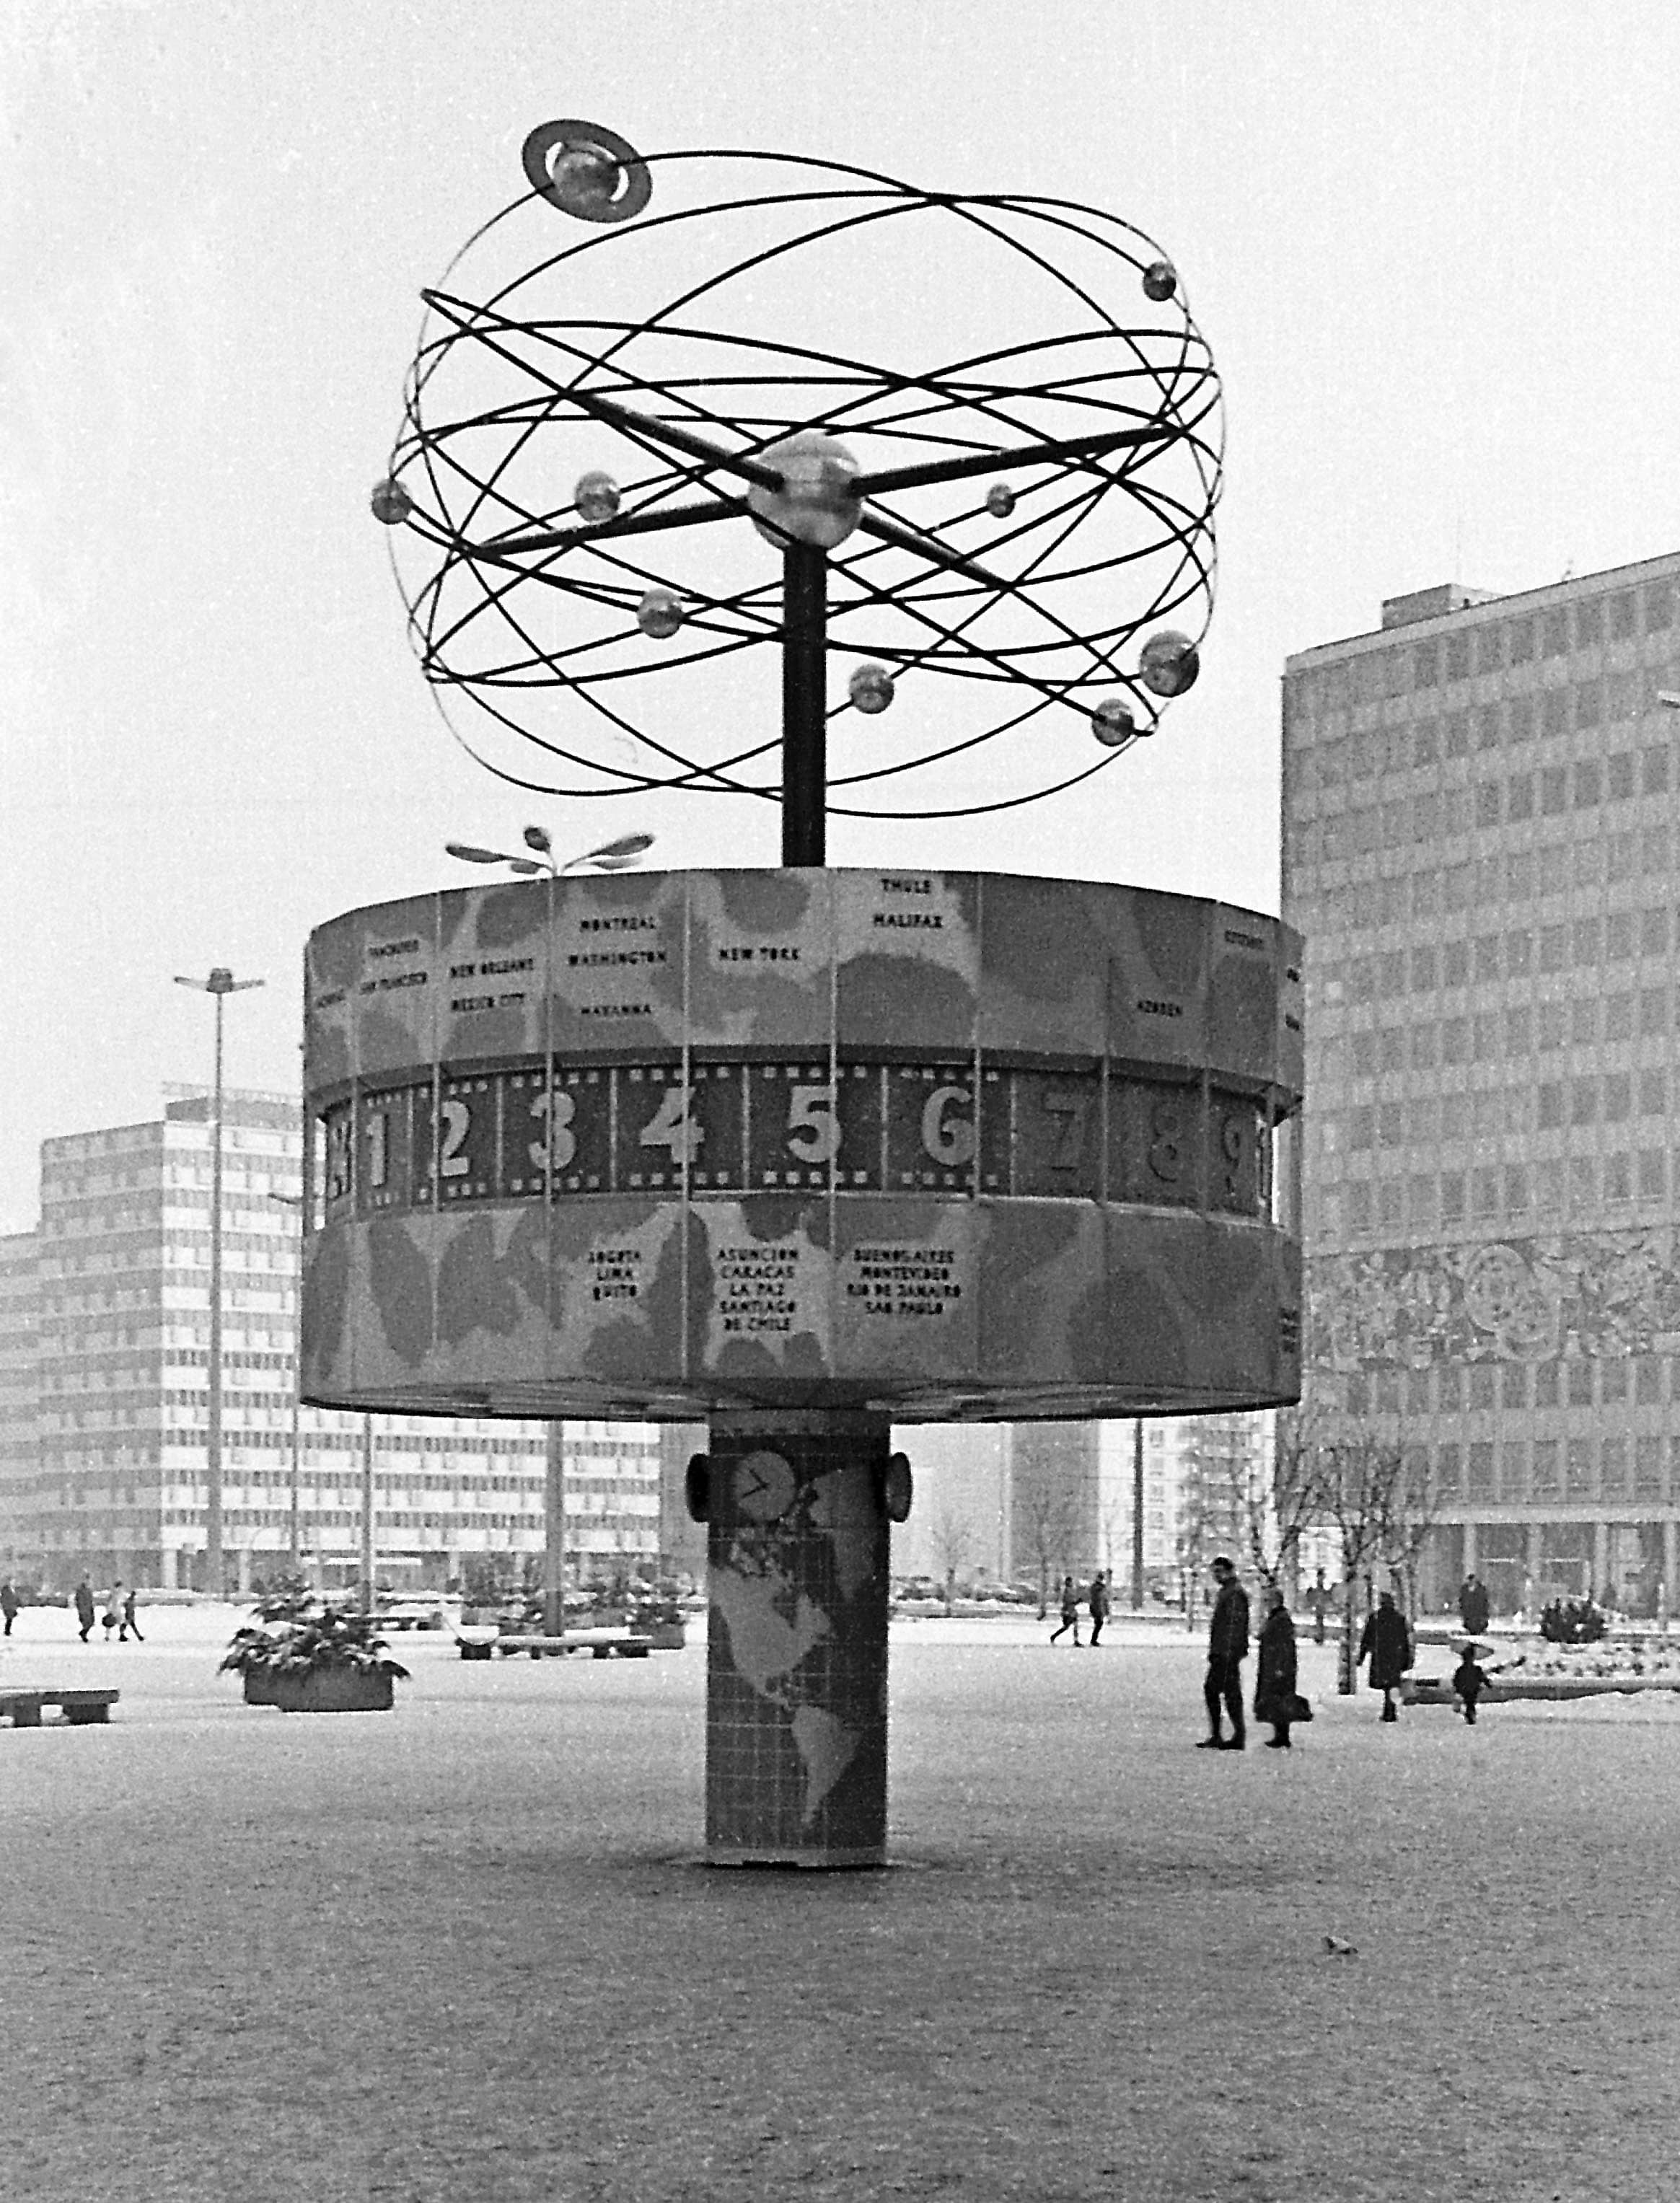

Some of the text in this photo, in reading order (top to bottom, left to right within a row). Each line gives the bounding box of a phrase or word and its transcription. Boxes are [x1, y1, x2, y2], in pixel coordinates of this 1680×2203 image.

[881, 879, 931, 894] THULE
[579, 917, 656, 933] MONTREAL
[873, 913, 943, 929] HALIFAX
[568, 951, 667, 967] WASHINGTON
[719, 946, 800, 962] NEW YORK
[528, 1091, 576, 1170] 3
[640, 1086, 705, 1164] 4
[788, 1085, 842, 1163] 5
[922, 1086, 975, 1166] 6
[430, 1101, 470, 1177] 2
[366, 1114, 388, 1187] 1
[597, 1267, 633, 1281] LIMA
[721, 1265, 795, 1279] CARACAS
[729, 1283, 784, 1296] LA PAZ
[875, 1283, 892, 1297] DE
[720, 1300, 796, 1314] SANTIAGO
[725, 1317, 790, 1331] DE CHILE
